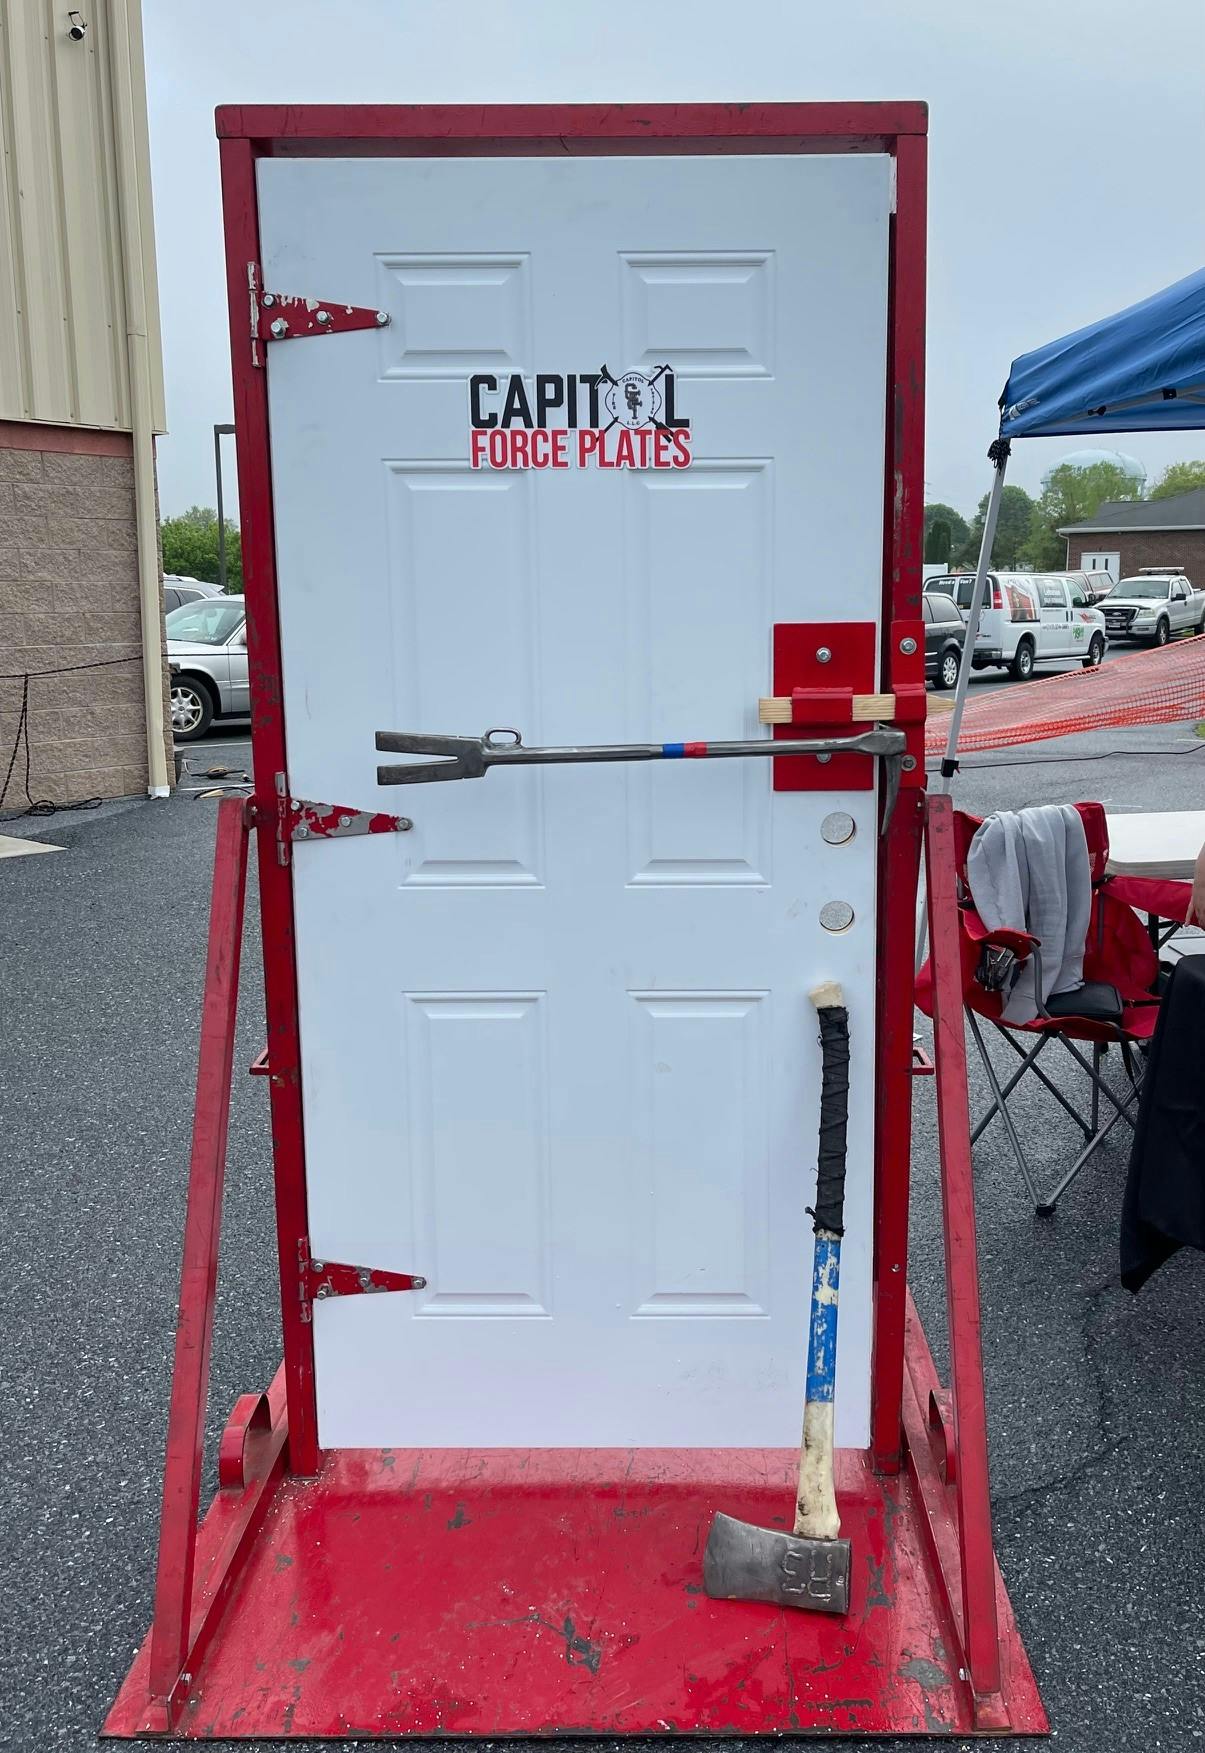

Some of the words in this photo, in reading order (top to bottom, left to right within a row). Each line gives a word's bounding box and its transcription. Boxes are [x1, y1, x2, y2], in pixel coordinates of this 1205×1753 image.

[622, 376, 644, 384] CAPITOL
[471, 429, 568, 468] FORCE
[579, 429, 691, 468] PLATES
